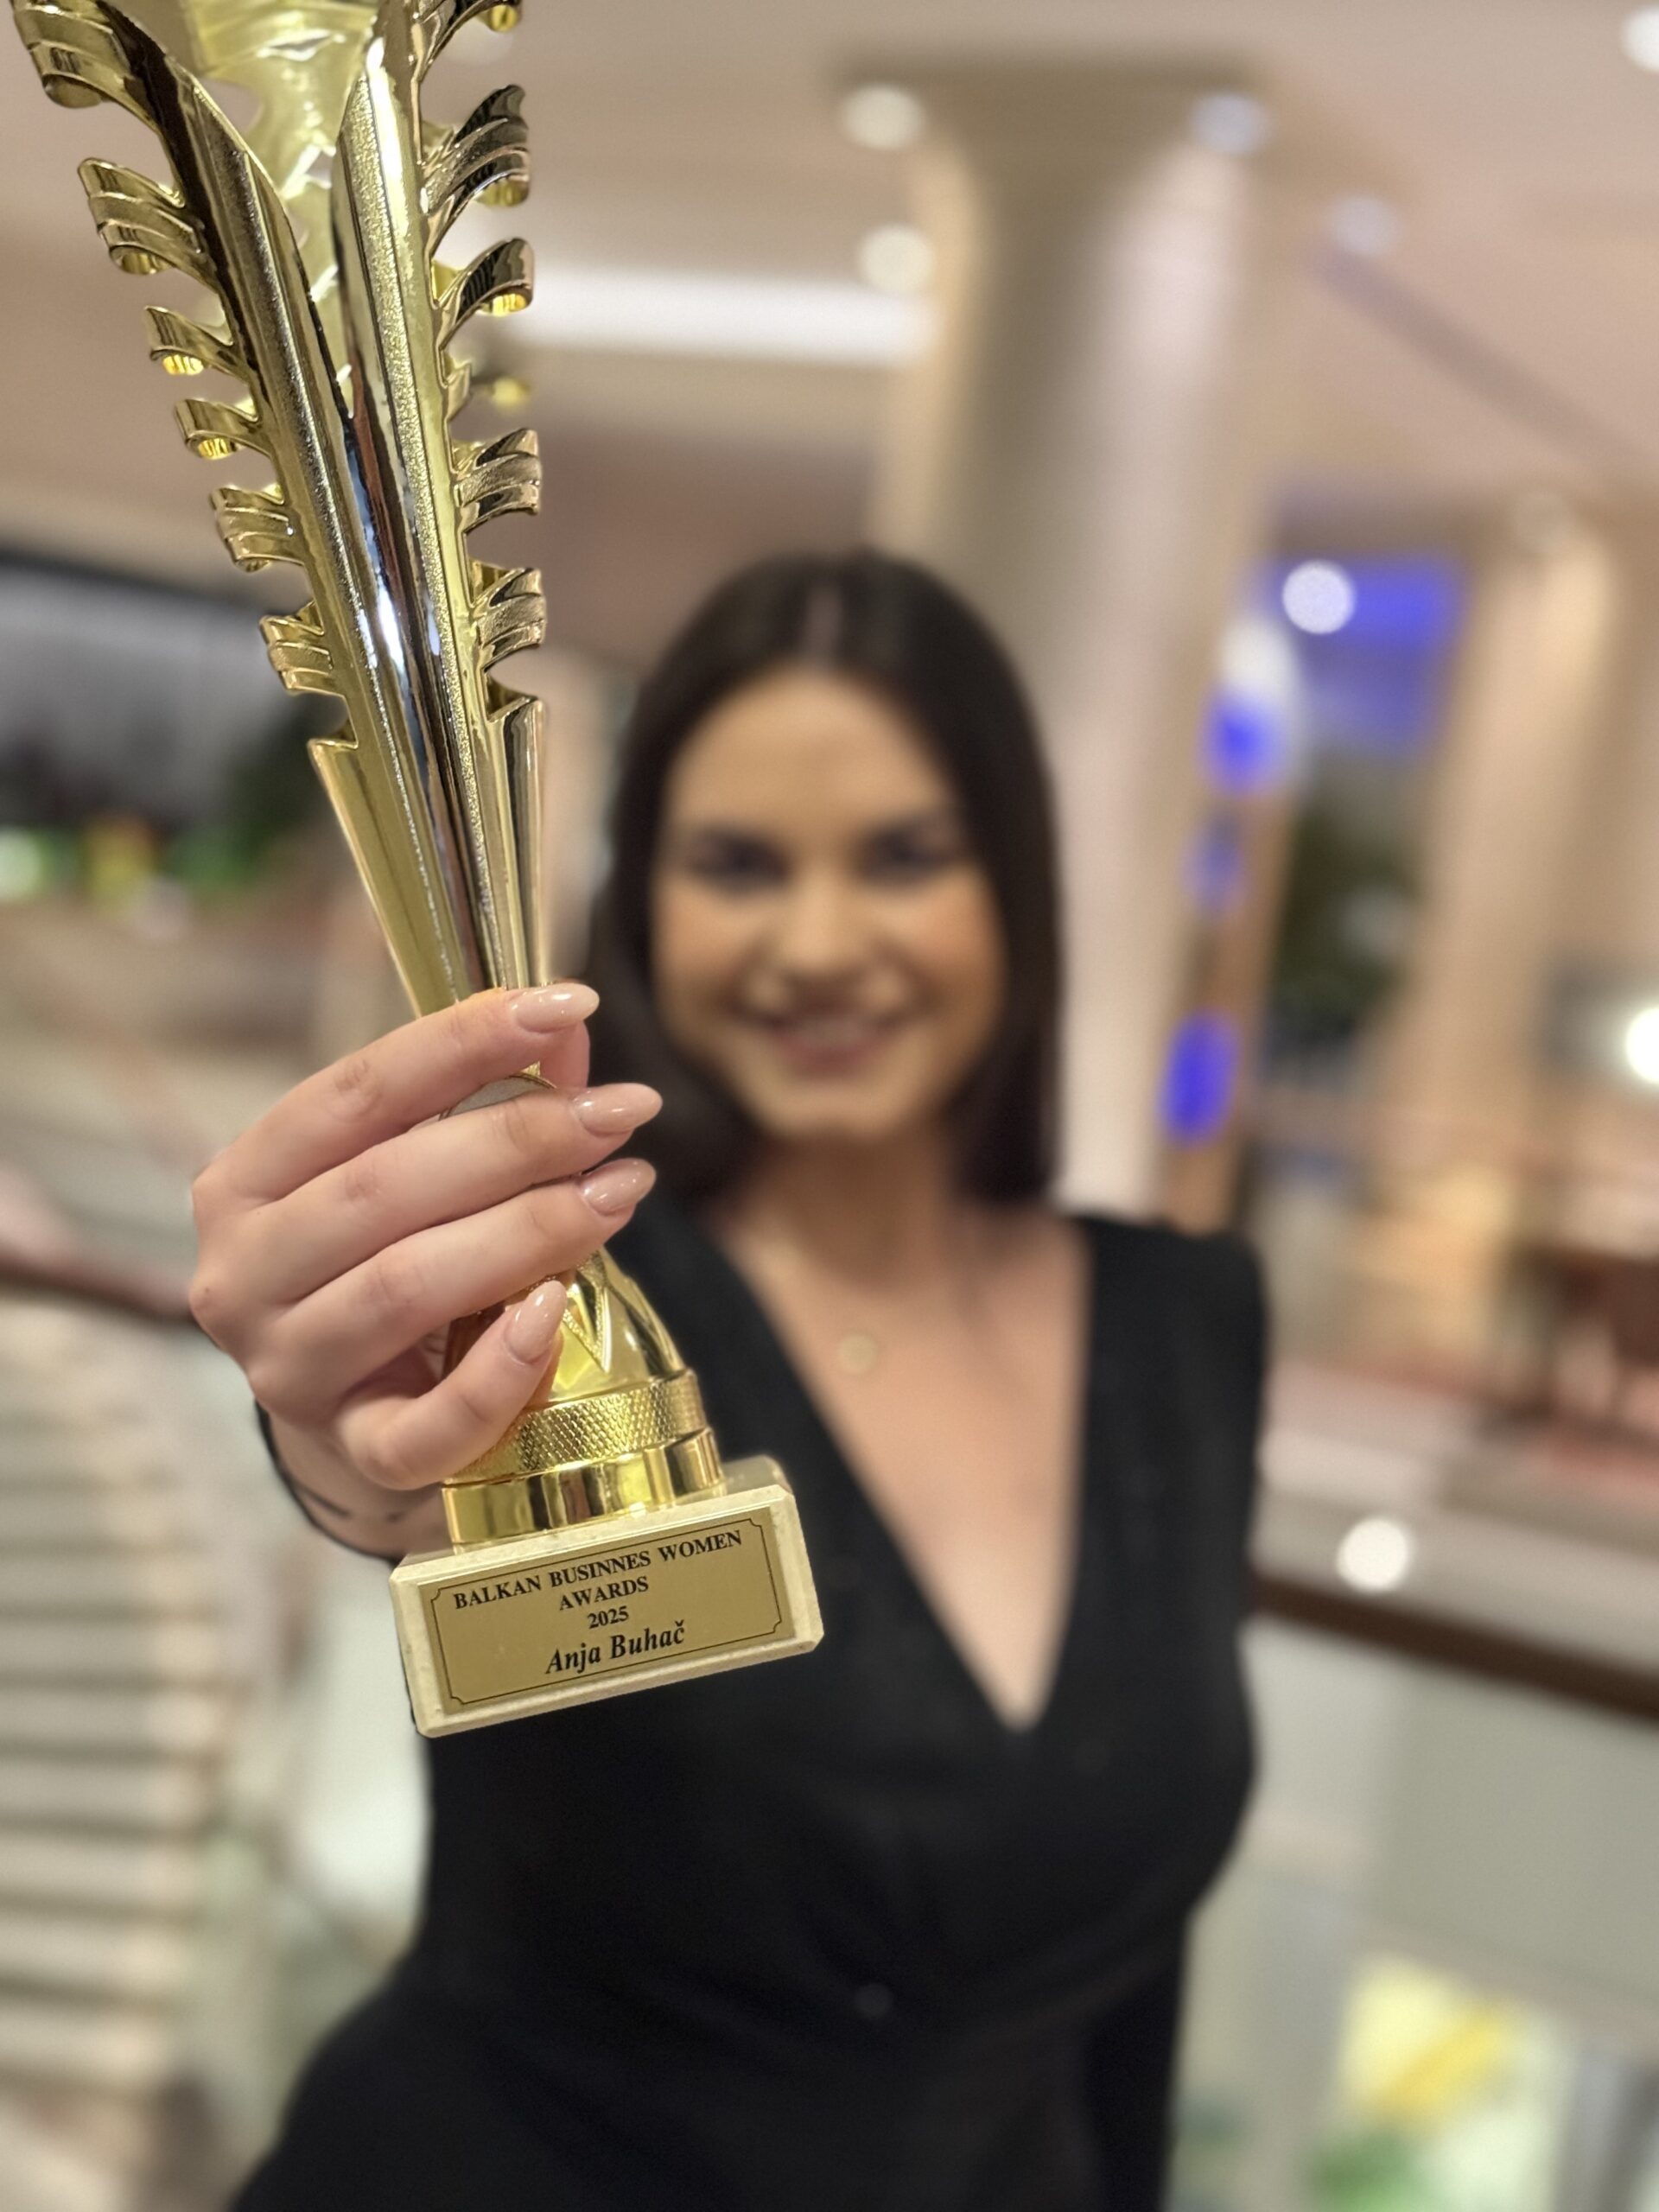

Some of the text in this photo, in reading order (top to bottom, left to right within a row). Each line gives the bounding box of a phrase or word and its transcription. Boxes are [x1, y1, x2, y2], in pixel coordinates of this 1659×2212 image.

[454, 1529, 742, 1610] BALKAN BUSINNES WOMEN
[558, 1576, 650, 1611] AWARDS
[587, 1605, 630, 1630] 2025
[545, 1619, 685, 1675] Anja Buhač
